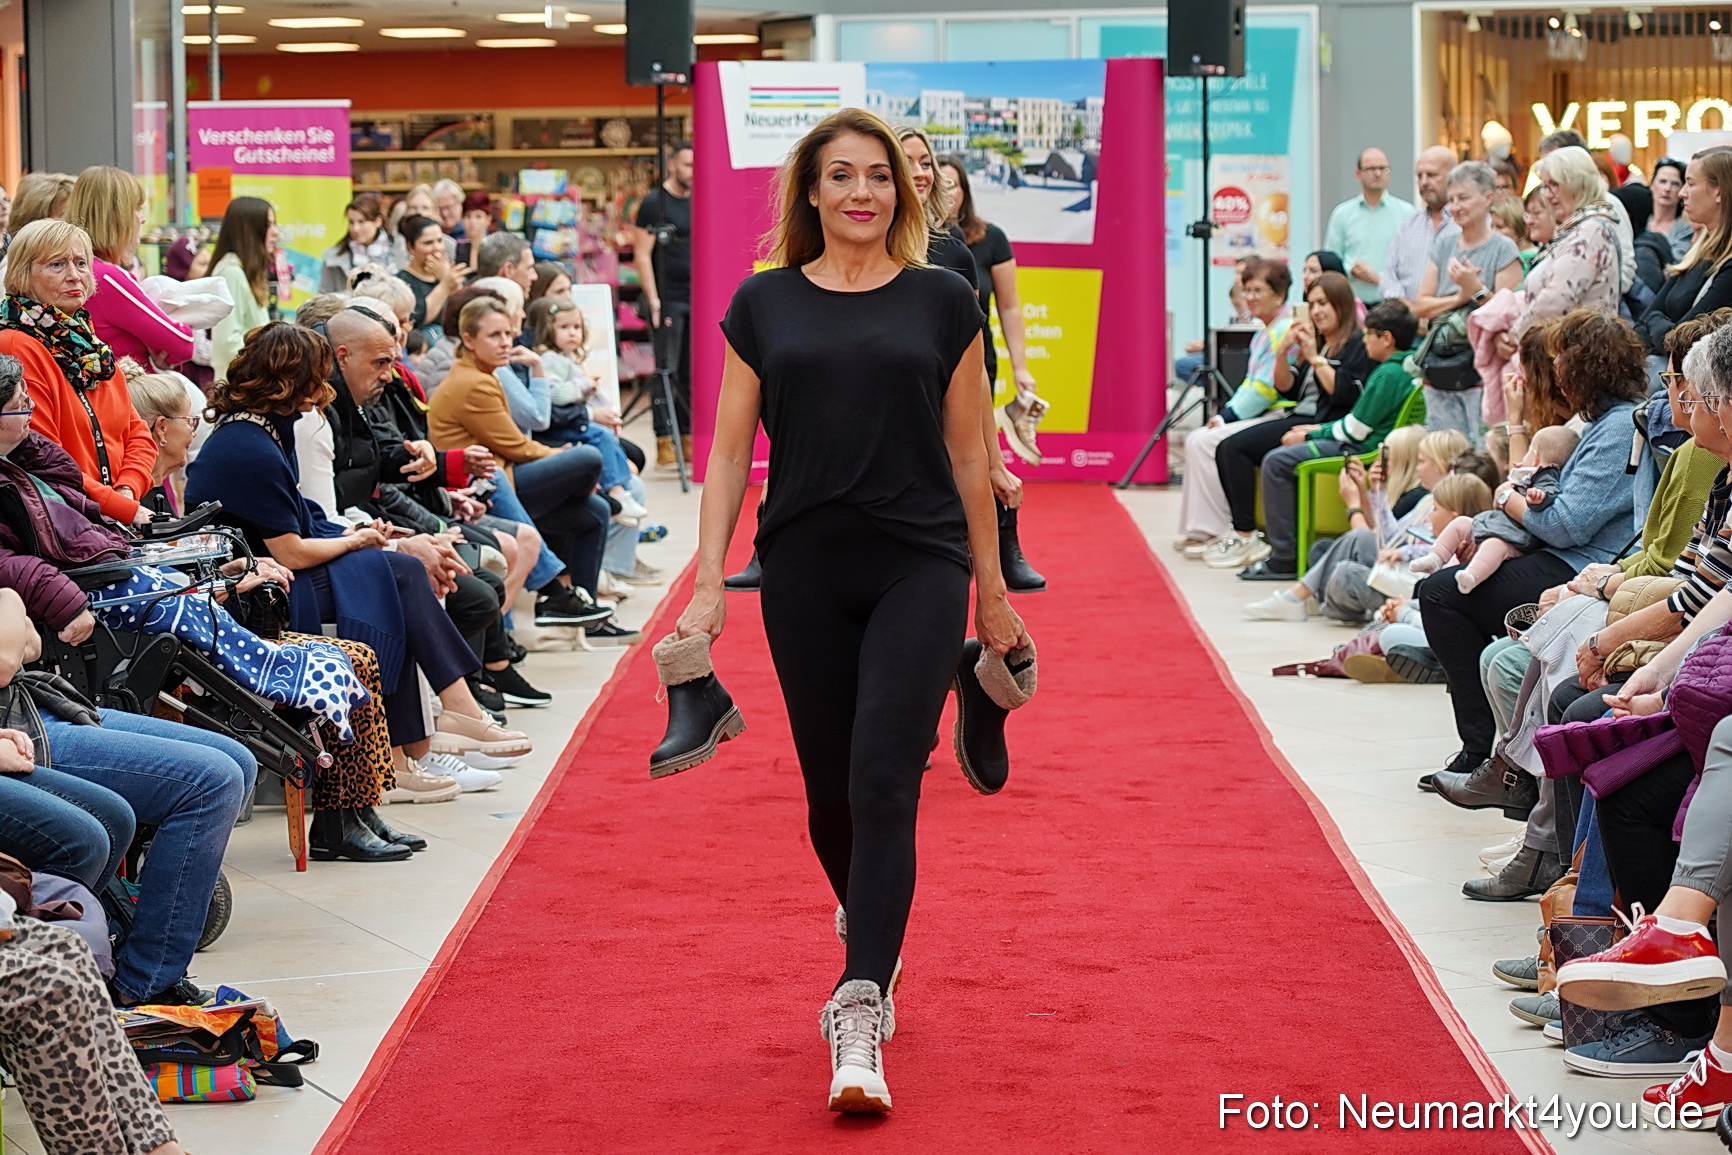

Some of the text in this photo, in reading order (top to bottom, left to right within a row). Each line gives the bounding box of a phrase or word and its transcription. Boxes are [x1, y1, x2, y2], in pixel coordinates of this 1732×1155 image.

[198, 126, 335, 146] Verschenken Sie
[233, 145, 335, 164] Gutscheine!
